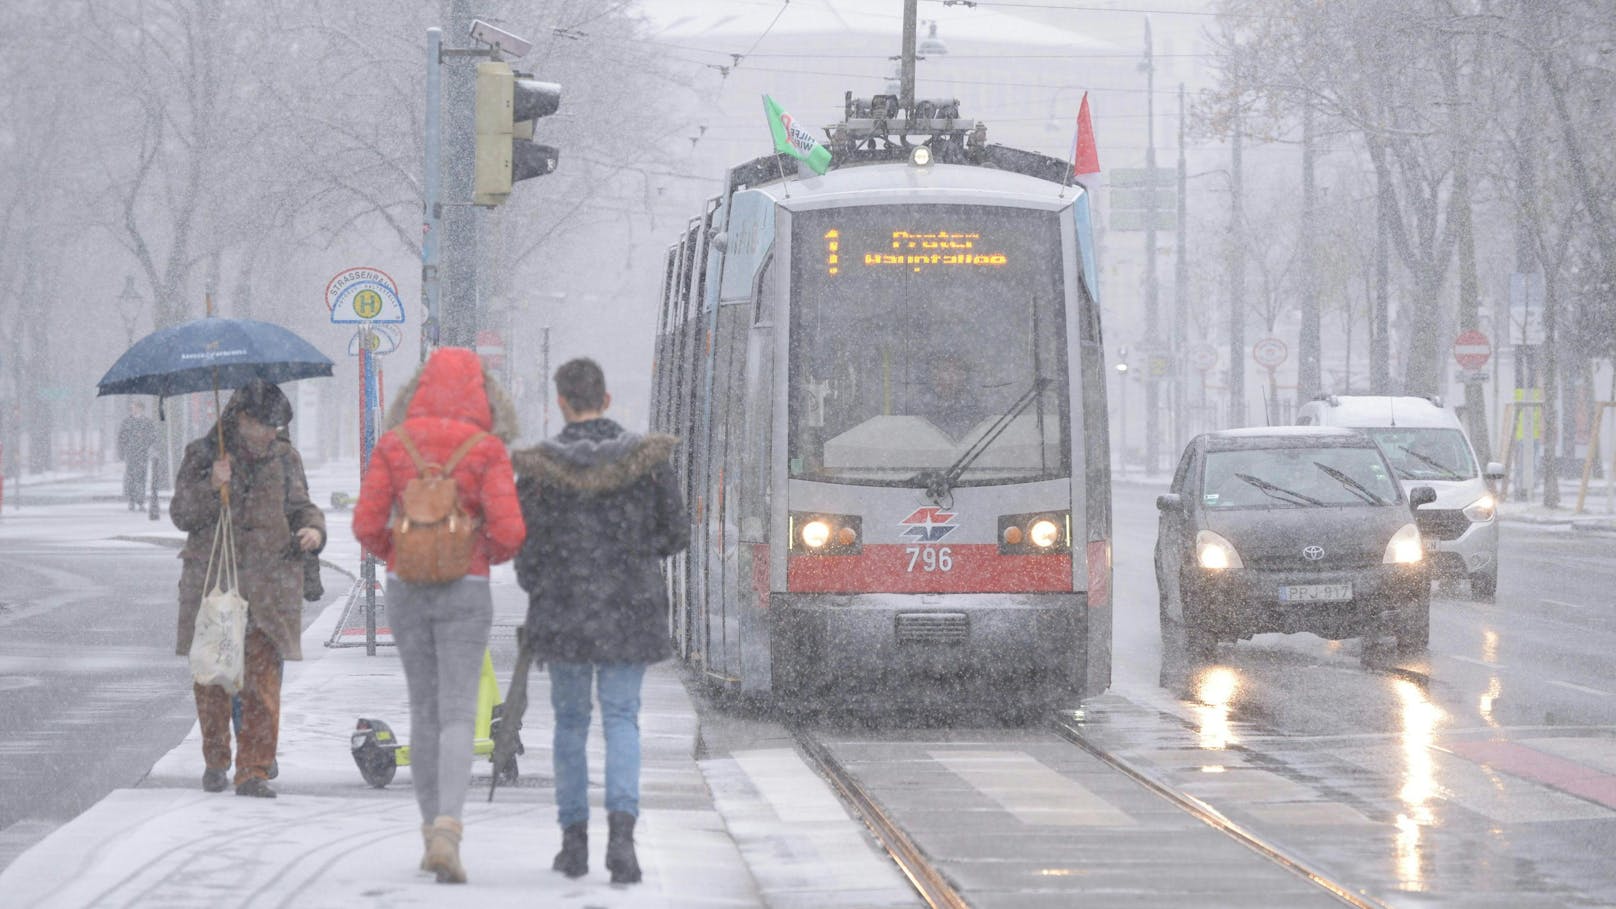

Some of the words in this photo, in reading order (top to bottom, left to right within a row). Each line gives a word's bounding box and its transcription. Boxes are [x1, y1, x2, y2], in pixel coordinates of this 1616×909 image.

[892, 231, 979, 249] Prater
[824, 229, 839, 276] 1
[361, 294, 375, 313] H
[906, 546, 953, 572] 796
